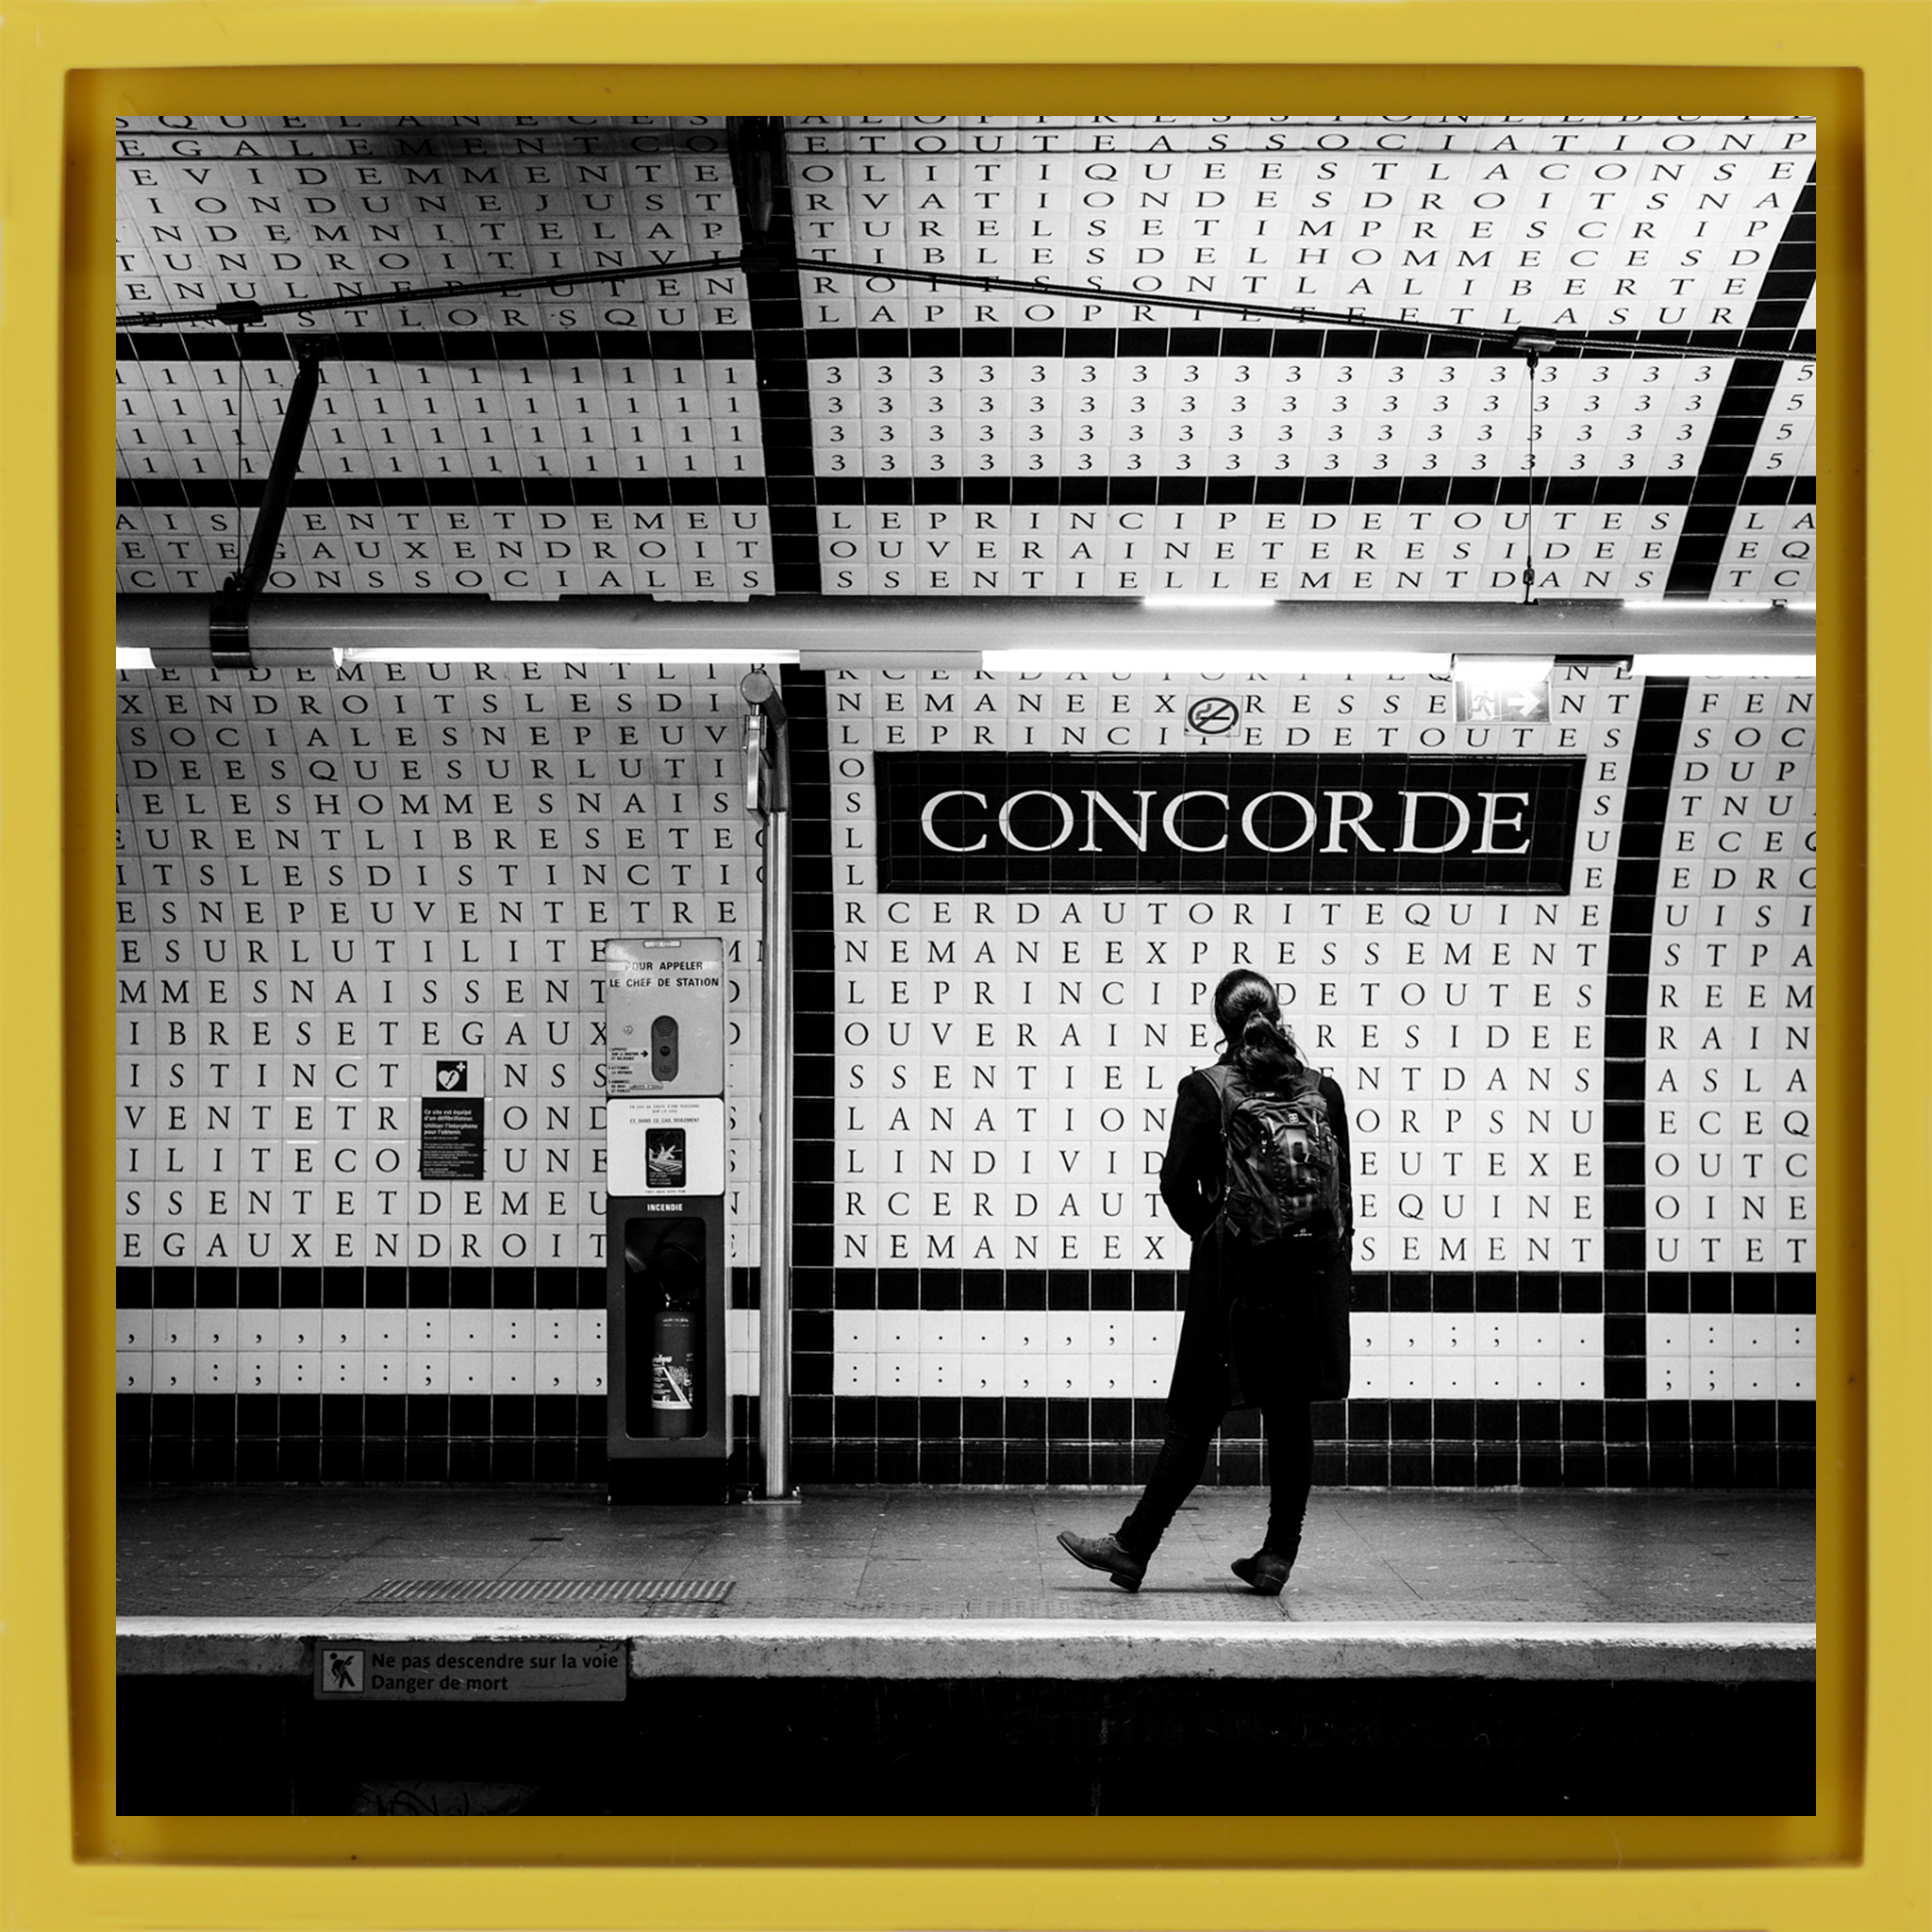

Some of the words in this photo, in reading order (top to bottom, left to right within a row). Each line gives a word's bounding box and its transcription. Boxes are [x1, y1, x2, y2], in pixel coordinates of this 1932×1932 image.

[921, 790, 1532, 854] CONCORDE
[659, 961, 703, 971] APPELER
[609, 978, 621, 988] LE
[626, 978, 652, 987] CHEF
[658, 977, 671, 987] DE
[676, 977, 719, 987] STATION
[647, 1203, 683, 1211] INCENDIE
[372, 1653, 395, 1668] Ne
[402, 1657, 432, 1673] pas
[436, 1653, 524, 1669] descendre
[530, 1657, 556, 1669] sur
[562, 1653, 577, 1669] la
[582, 1653, 619, 1669] voie
[372, 1675, 434, 1694] Danger
[440, 1674, 460, 1690] de
[467, 1676, 508, 1690] mort
